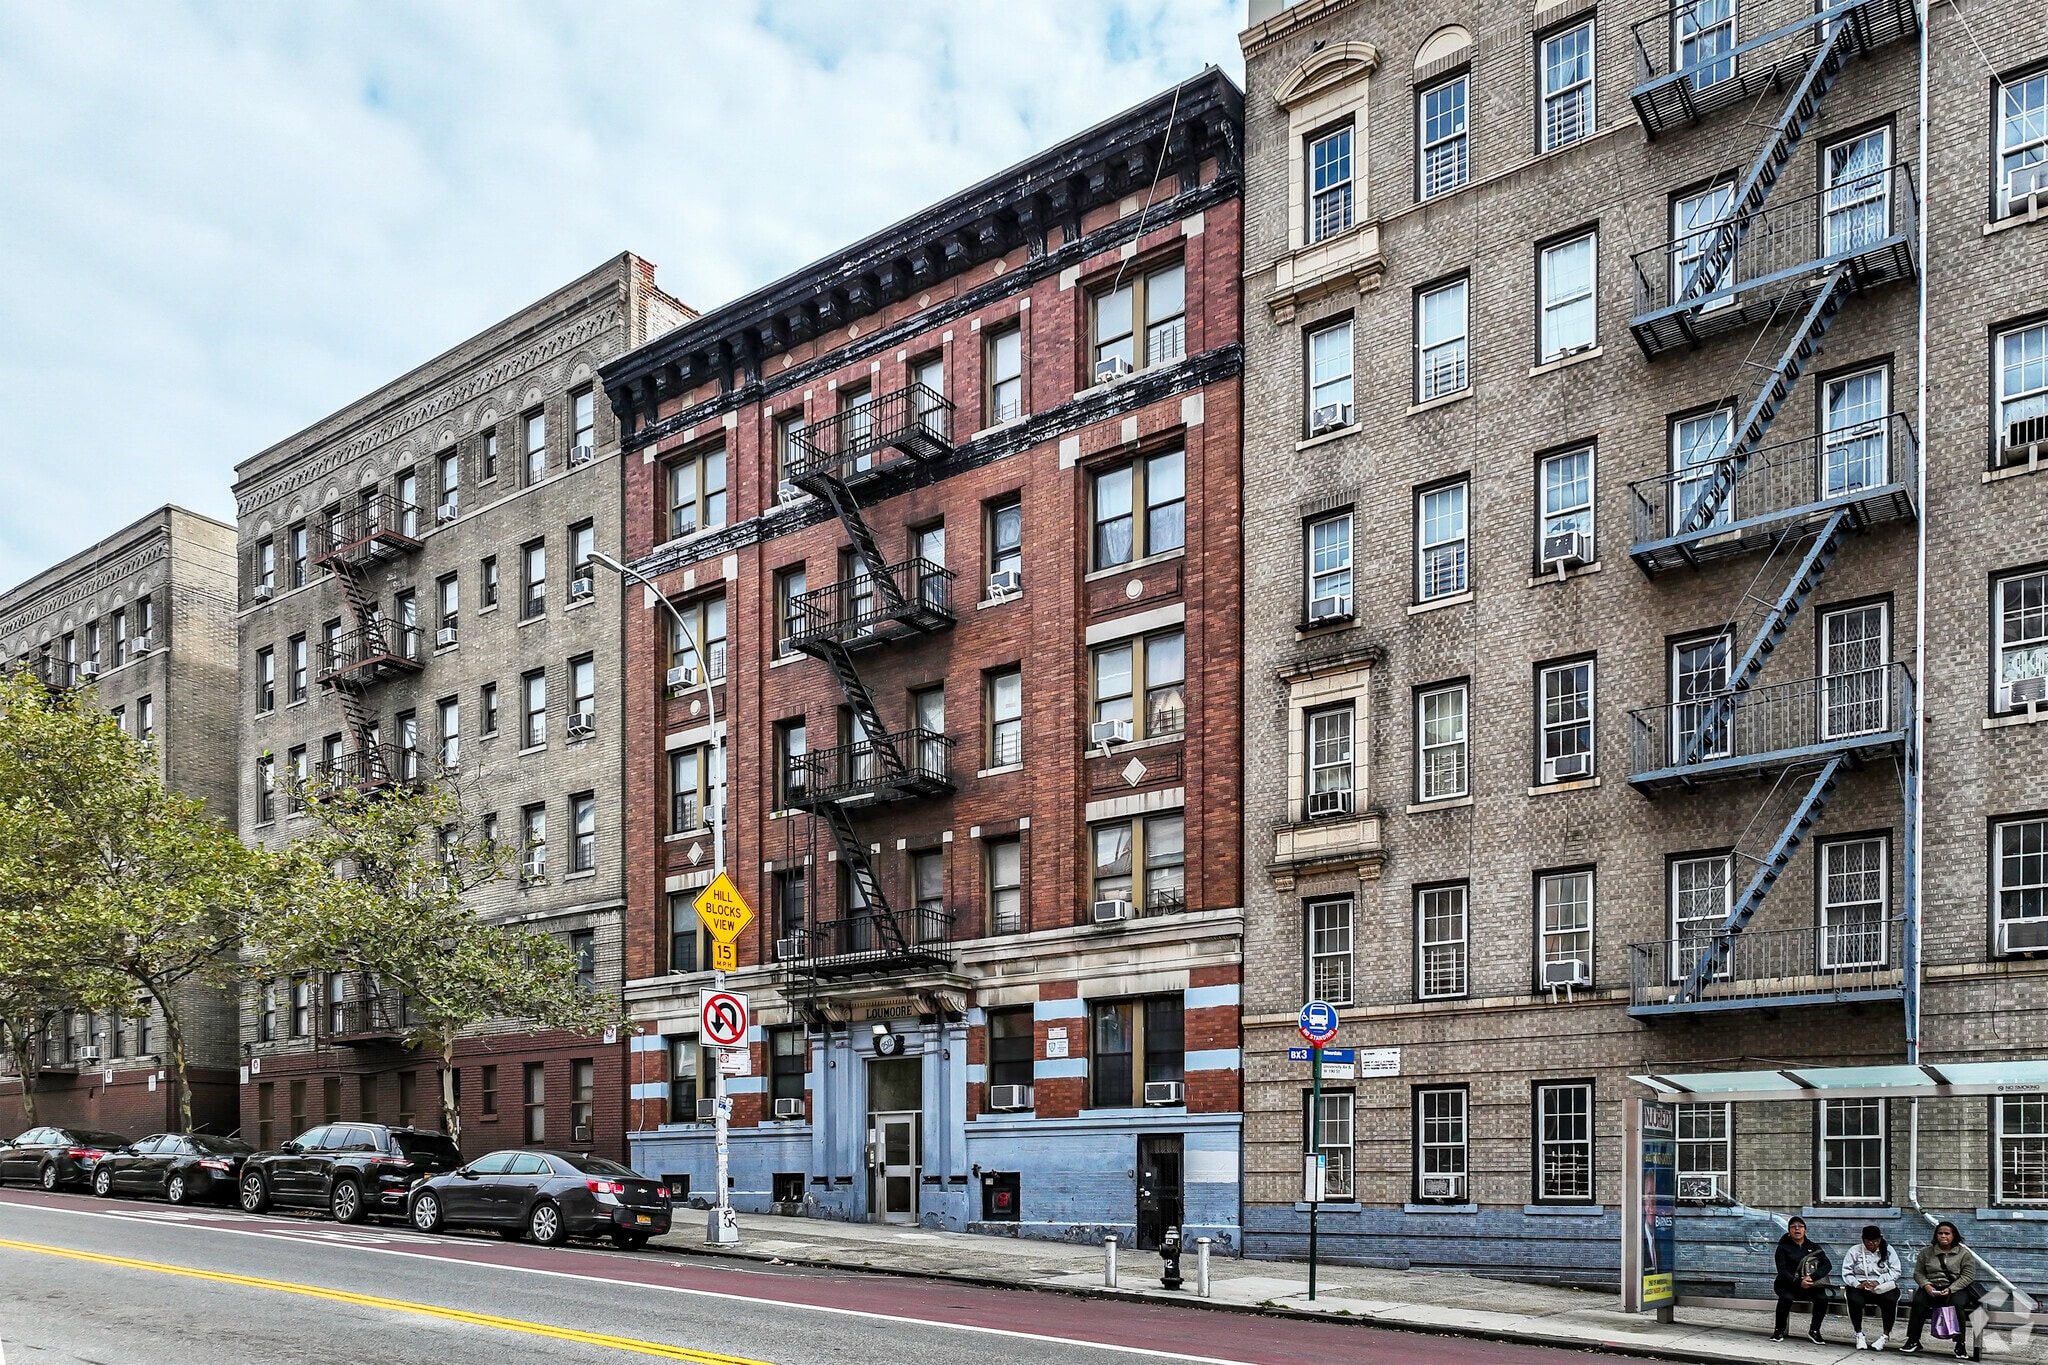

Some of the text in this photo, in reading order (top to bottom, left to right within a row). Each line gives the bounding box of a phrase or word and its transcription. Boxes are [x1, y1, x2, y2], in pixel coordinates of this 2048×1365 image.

[714, 889, 733, 902] HILL
[706, 903, 741, 918] BLOCKS
[713, 918, 735, 931] VIEW
[717, 945, 732, 960] 15
[866, 1005, 912, 1019] LOUMOORE
[1302, 1027, 1335, 1041] NO STANDING
[1290, 1050, 1308, 1059] BX3
